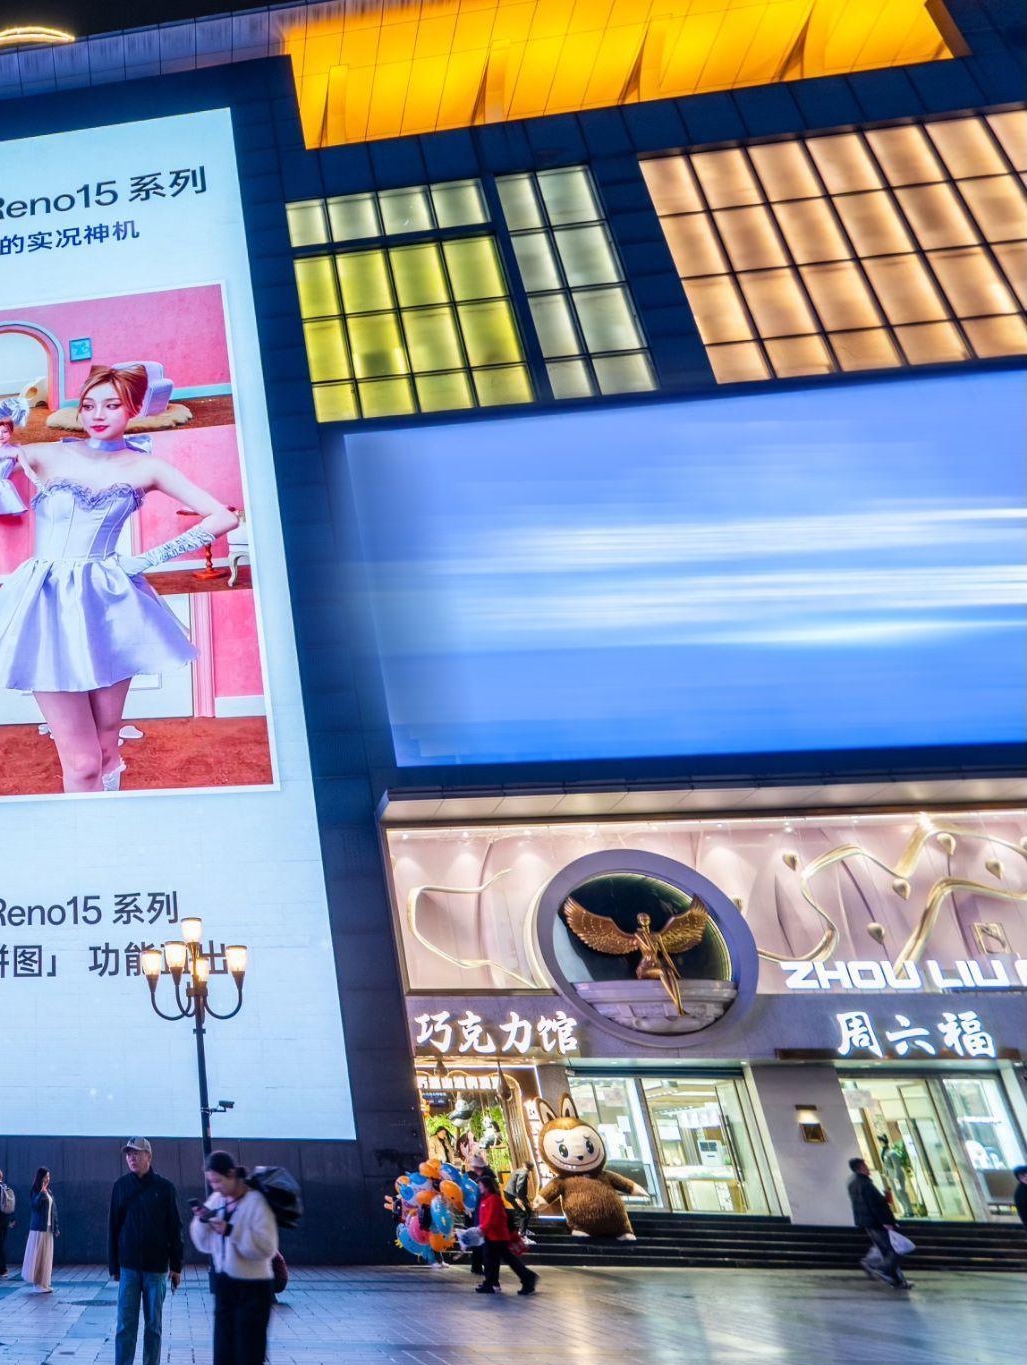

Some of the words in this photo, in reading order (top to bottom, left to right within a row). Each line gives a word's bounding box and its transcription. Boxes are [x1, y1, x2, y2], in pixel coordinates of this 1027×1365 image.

[129, 166, 207, 203] 系列
[113, 891, 179, 925] 系列
[89, 940, 228, 977] 功能出
[780, 960, 922, 989] ZHOU
[926, 959, 1011, 988] LIU
[414, 1010, 579, 1054] 巧克力馆
[836, 1010, 998, 1058] 周六福
